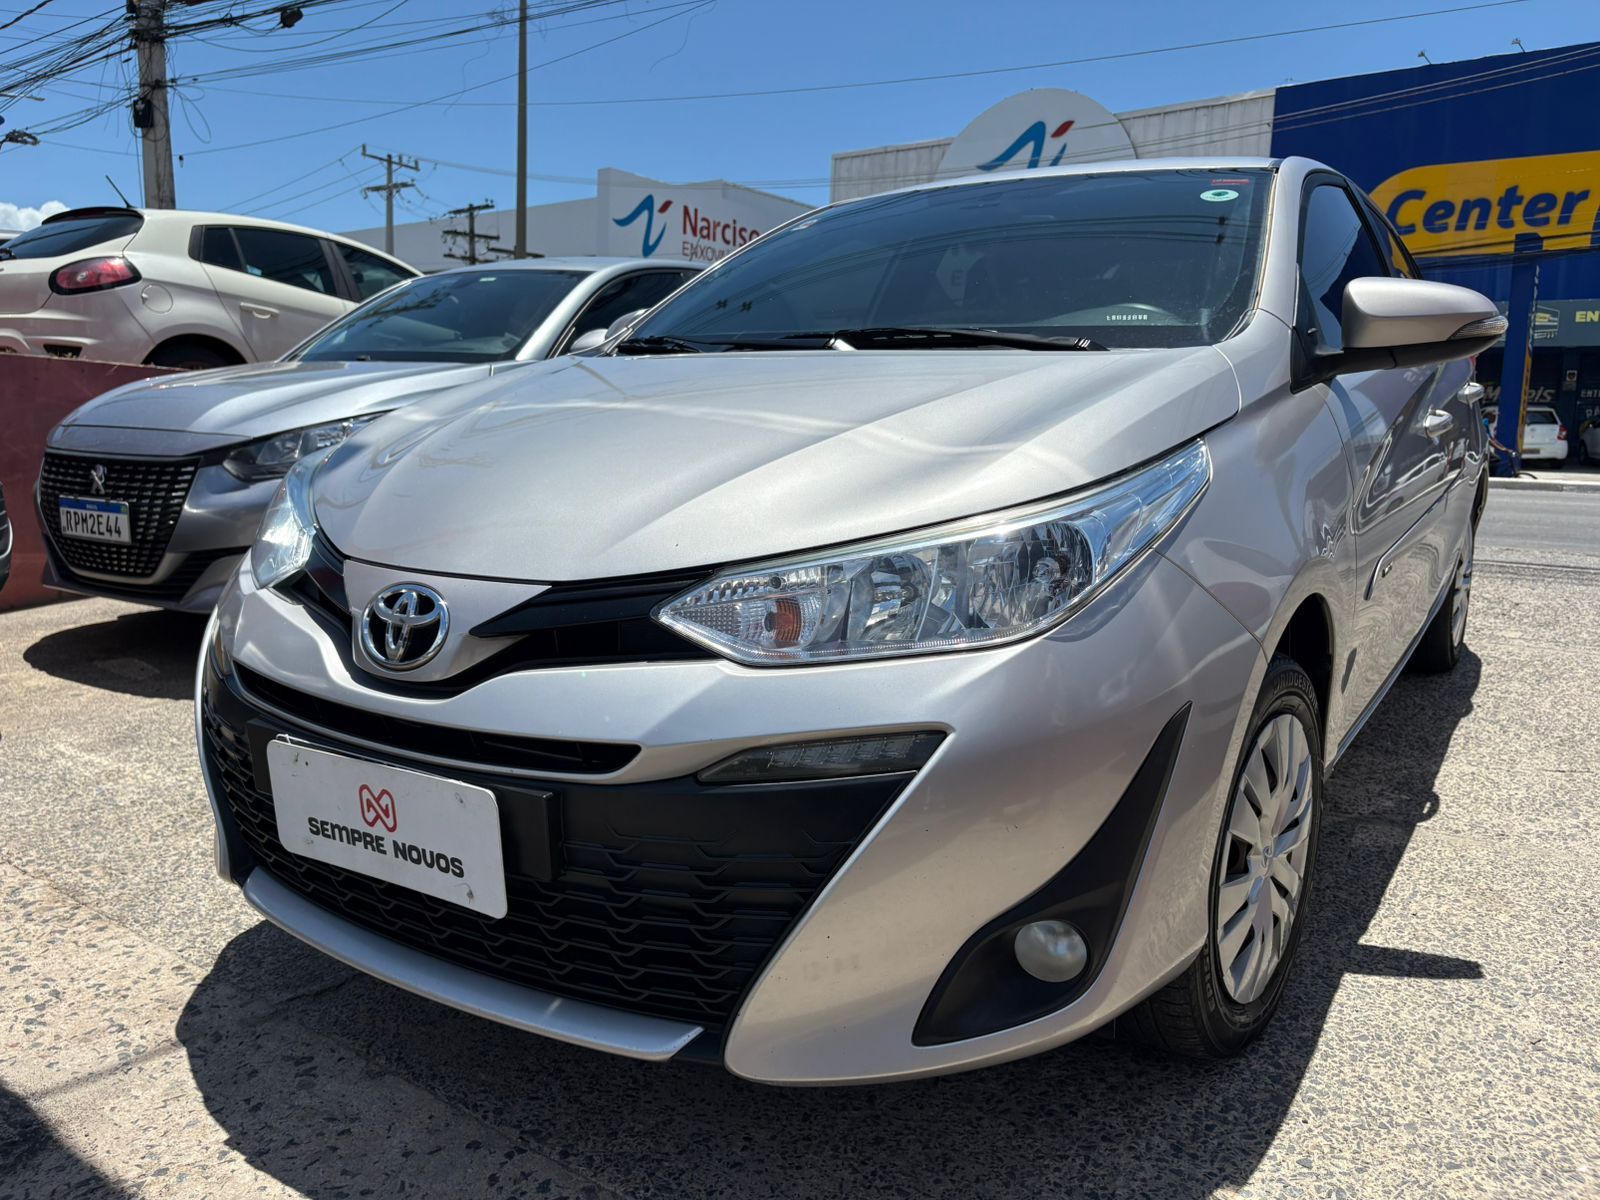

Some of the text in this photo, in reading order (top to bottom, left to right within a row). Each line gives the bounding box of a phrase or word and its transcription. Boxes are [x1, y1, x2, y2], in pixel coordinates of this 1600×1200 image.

[1386, 185, 1590, 235] Center
[66, 510, 121, 538] RPM2E44
[307, 817, 387, 855] SEMPRE
